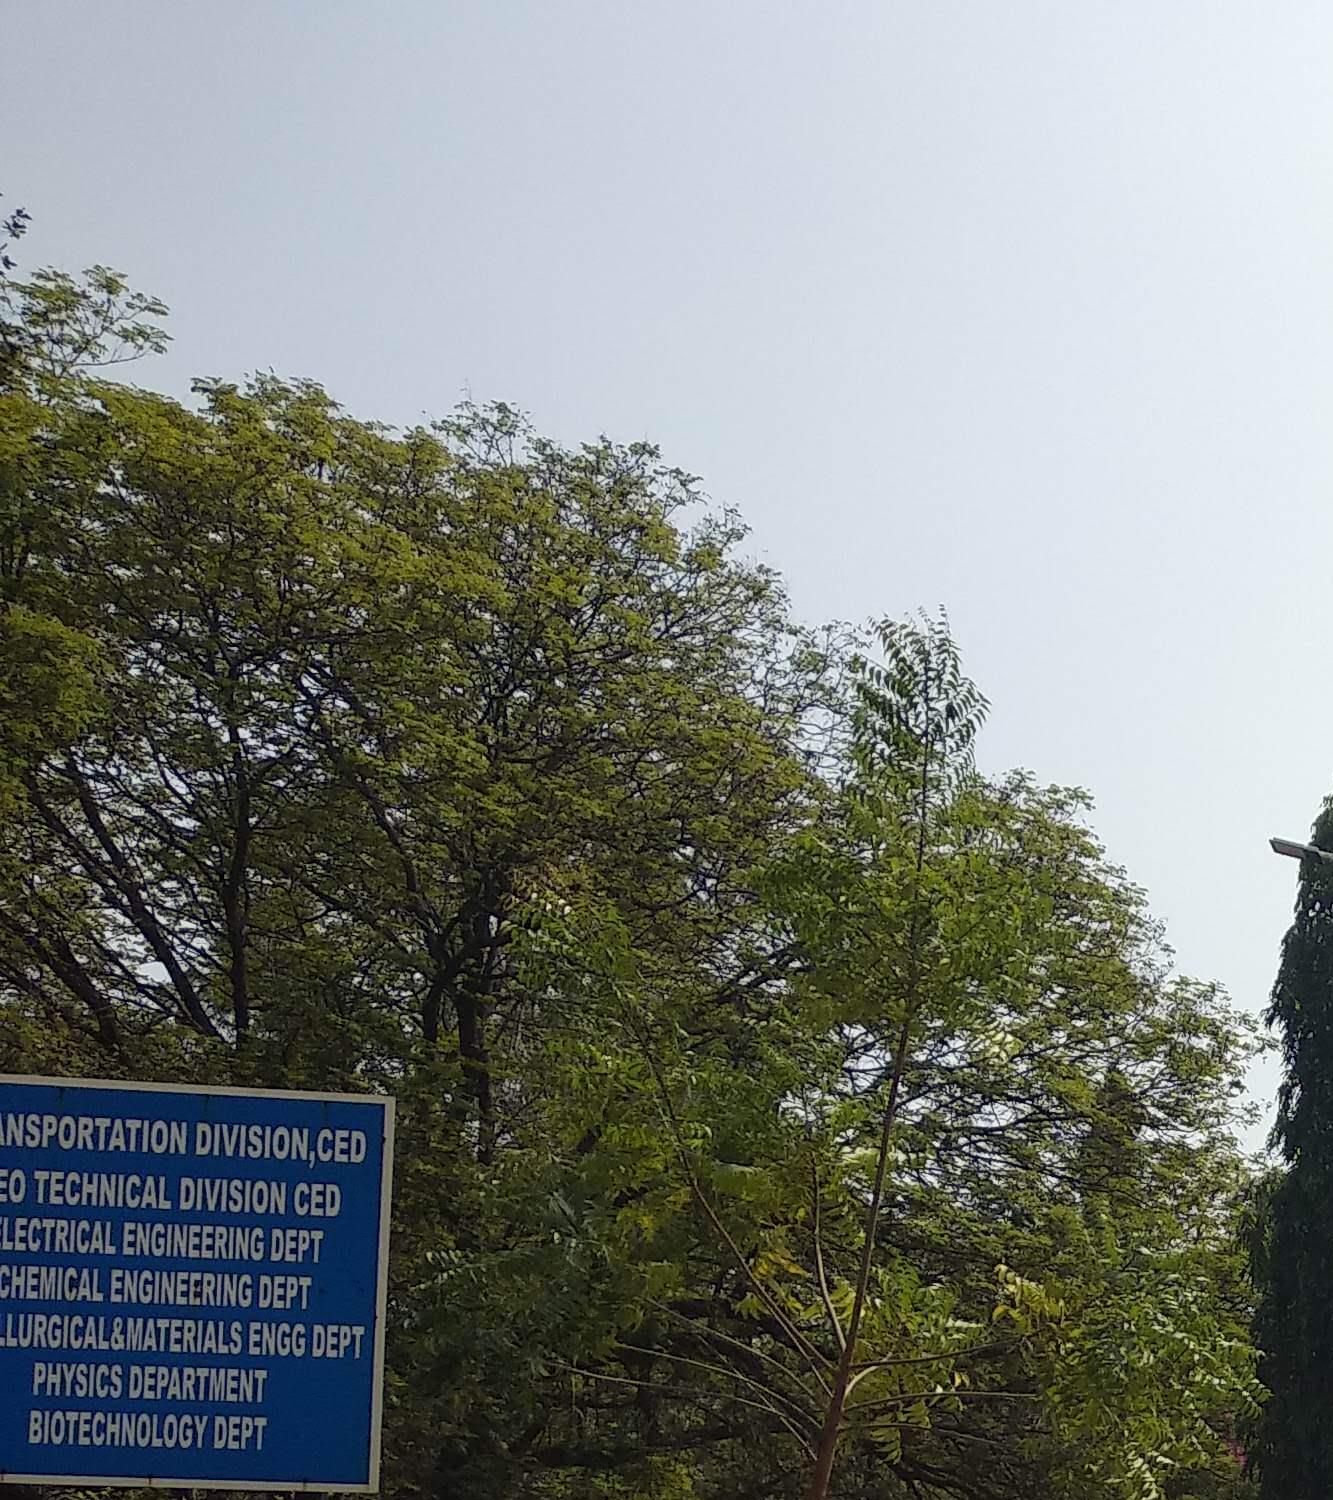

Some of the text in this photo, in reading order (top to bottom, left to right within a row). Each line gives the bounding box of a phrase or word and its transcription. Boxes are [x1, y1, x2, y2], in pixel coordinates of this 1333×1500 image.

[195, 1121, 367, 1169] DIVISION,CED
[34, 1170, 172, 1210] TECHNICAL
[179, 1177, 287, 1215] DIVISION
[294, 1182, 342, 1217] CED
[0, 1216, 324, 1264] LECTRICAL ENGINEERING DEPT
[0, 1264, 312, 1310] CHEMICAL ENGINEERING DEPT
[249, 1321, 306, 1358] ENGG
[312, 1324, 365, 1360] DEPT
[33, 1362, 268, 1403] PHYSICS DEPARTMENT
[28, 1410, 267, 1451] BIOTECHNOLOGY DEPT
